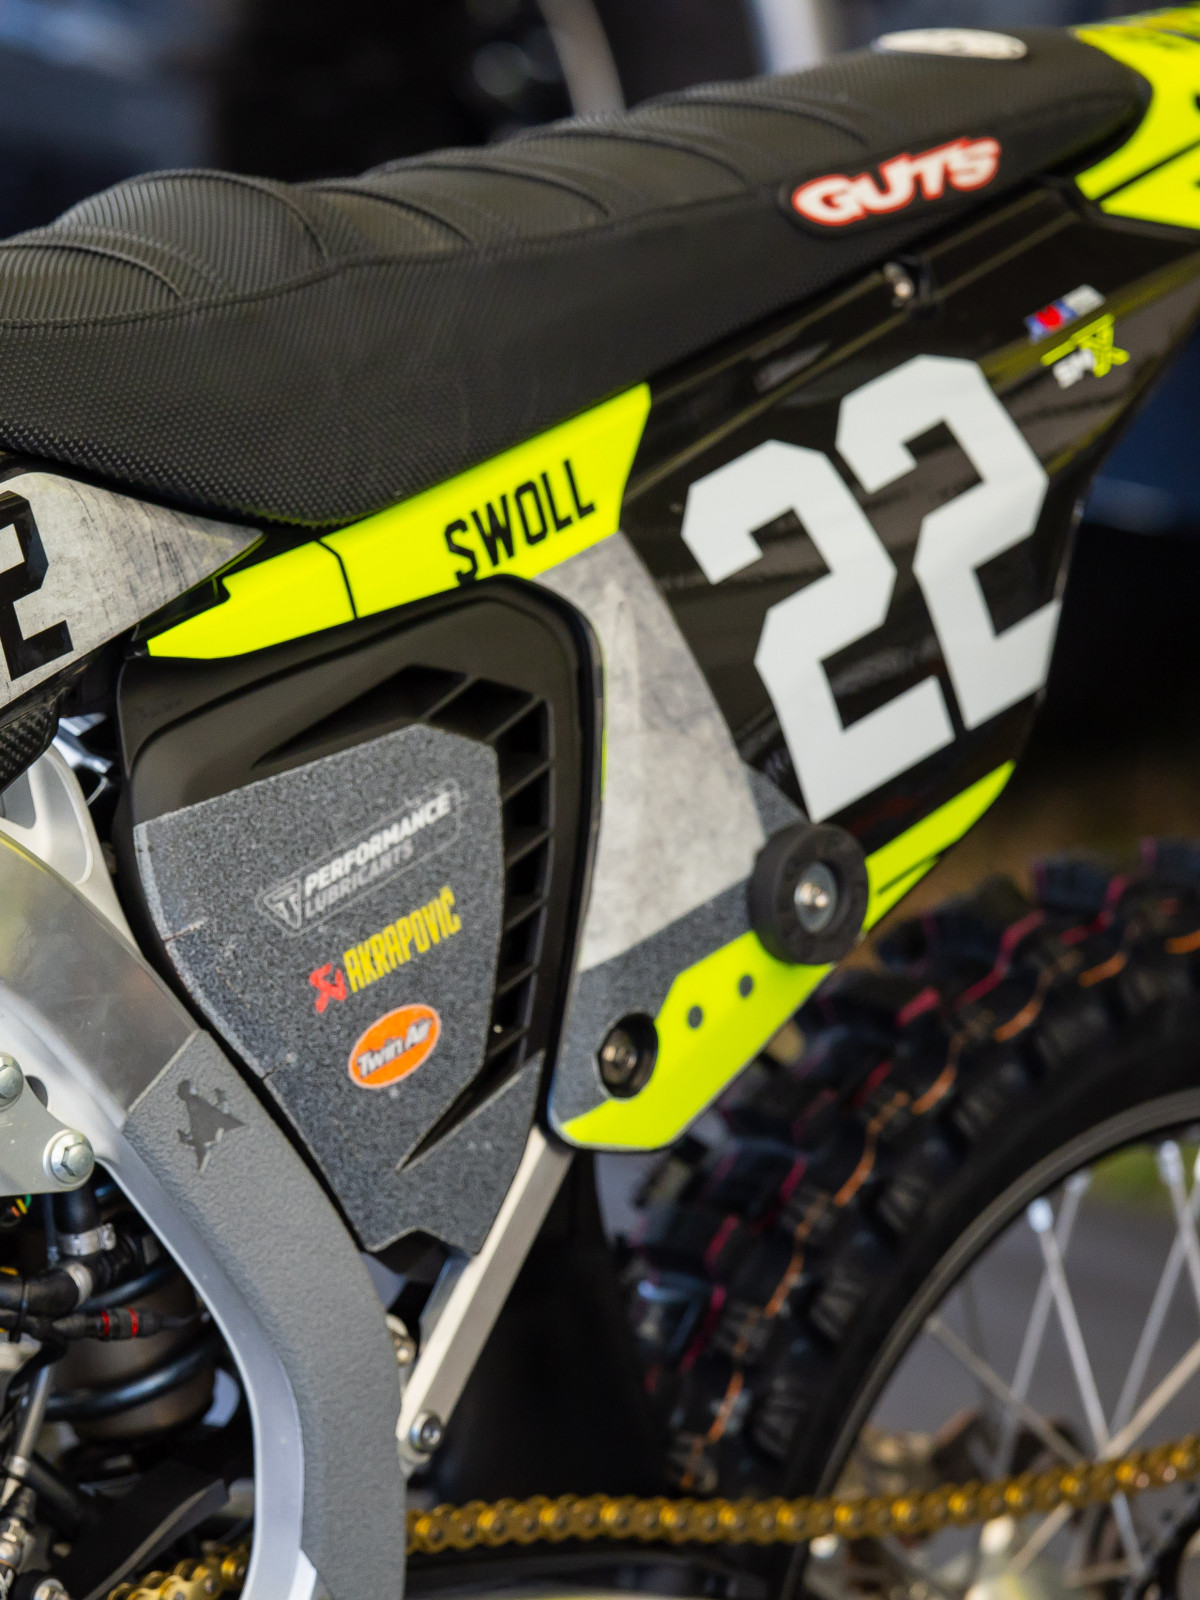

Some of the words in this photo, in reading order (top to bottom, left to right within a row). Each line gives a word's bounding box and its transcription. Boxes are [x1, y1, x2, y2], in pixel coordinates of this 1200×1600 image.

[792, 137, 1001, 226] GUTS
[444, 458, 596, 584] SWOLL
[681, 353, 1061, 824] 22
[304, 792, 451, 897] PERFORMANCE
[356, 1035, 404, 1079] Twin
[403, 1017, 434, 1053] Air
